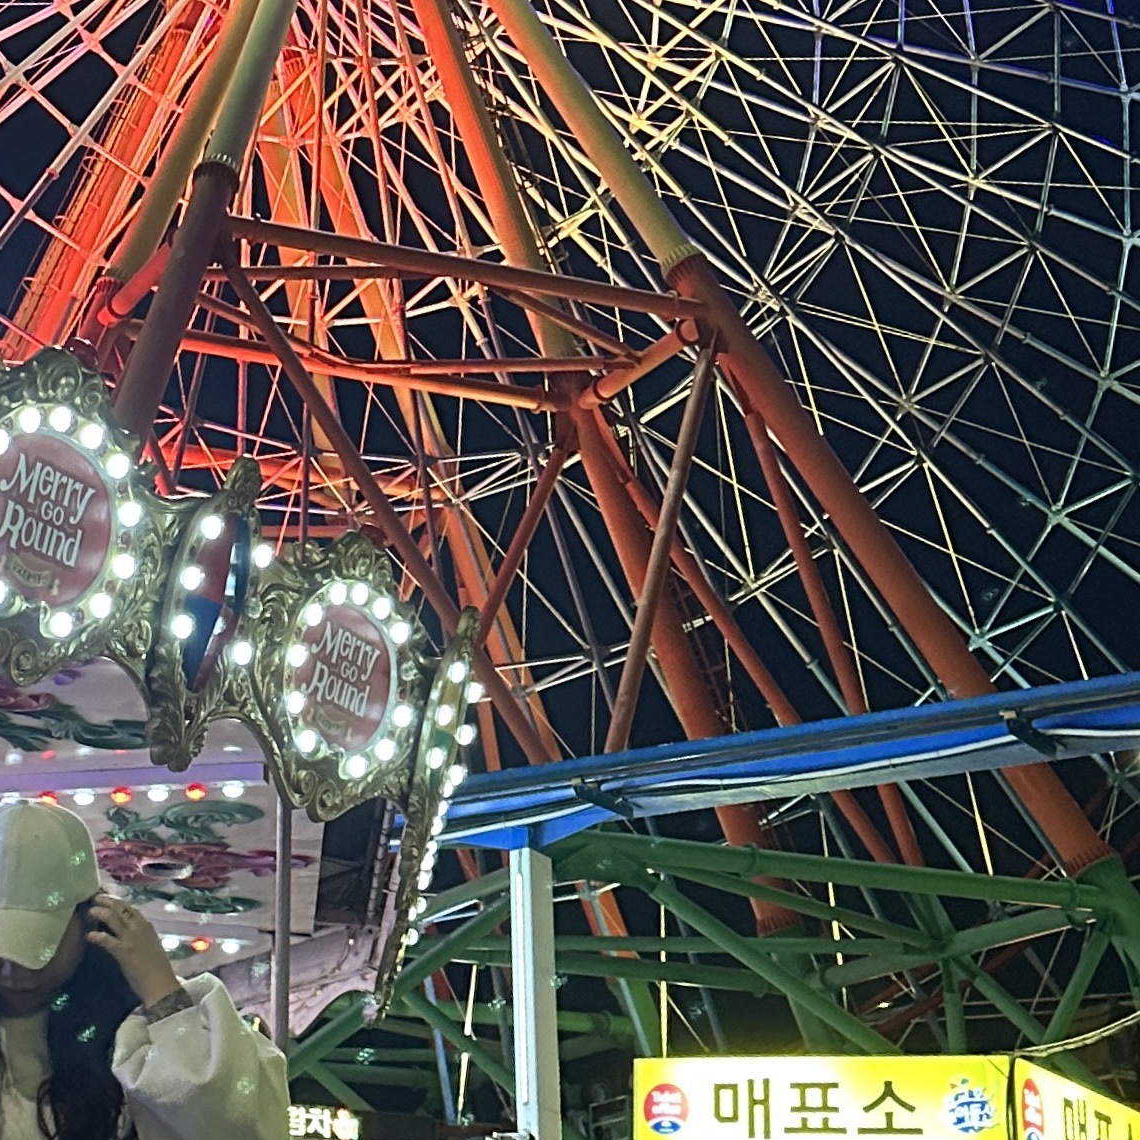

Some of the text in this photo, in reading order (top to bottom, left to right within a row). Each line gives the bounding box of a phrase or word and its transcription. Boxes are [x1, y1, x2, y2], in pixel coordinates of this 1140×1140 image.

[0, 452, 96, 525] Merry
[41, 500, 64, 526] GO
[311, 621, 381, 682] Merry
[340, 661, 358, 682] GO
[300, 660, 371, 718] Round
[713, 1077, 924, 1140] 매표소
